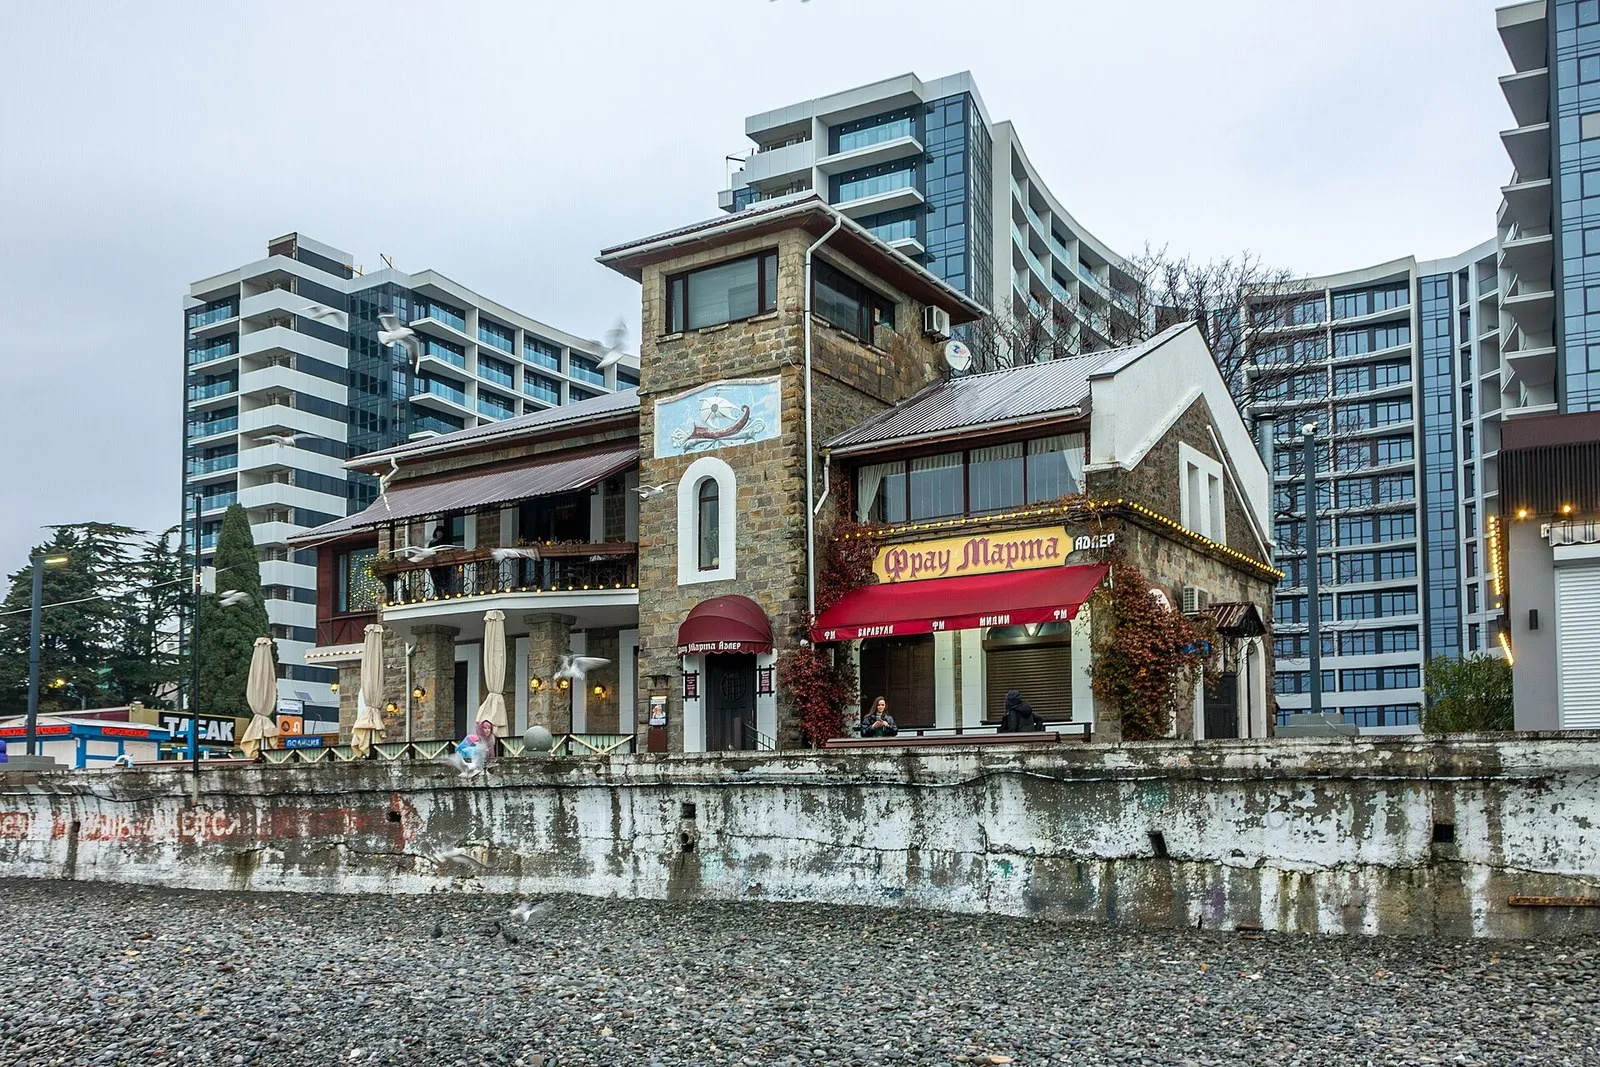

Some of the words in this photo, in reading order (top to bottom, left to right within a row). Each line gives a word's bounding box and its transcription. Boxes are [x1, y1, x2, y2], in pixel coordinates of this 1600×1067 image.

[884, 545, 951, 580] Фрау
[956, 536, 1060, 571] Марта
[979, 614, 1010, 627] МИДИИ
[163, 716, 234, 742] ТАБАК
